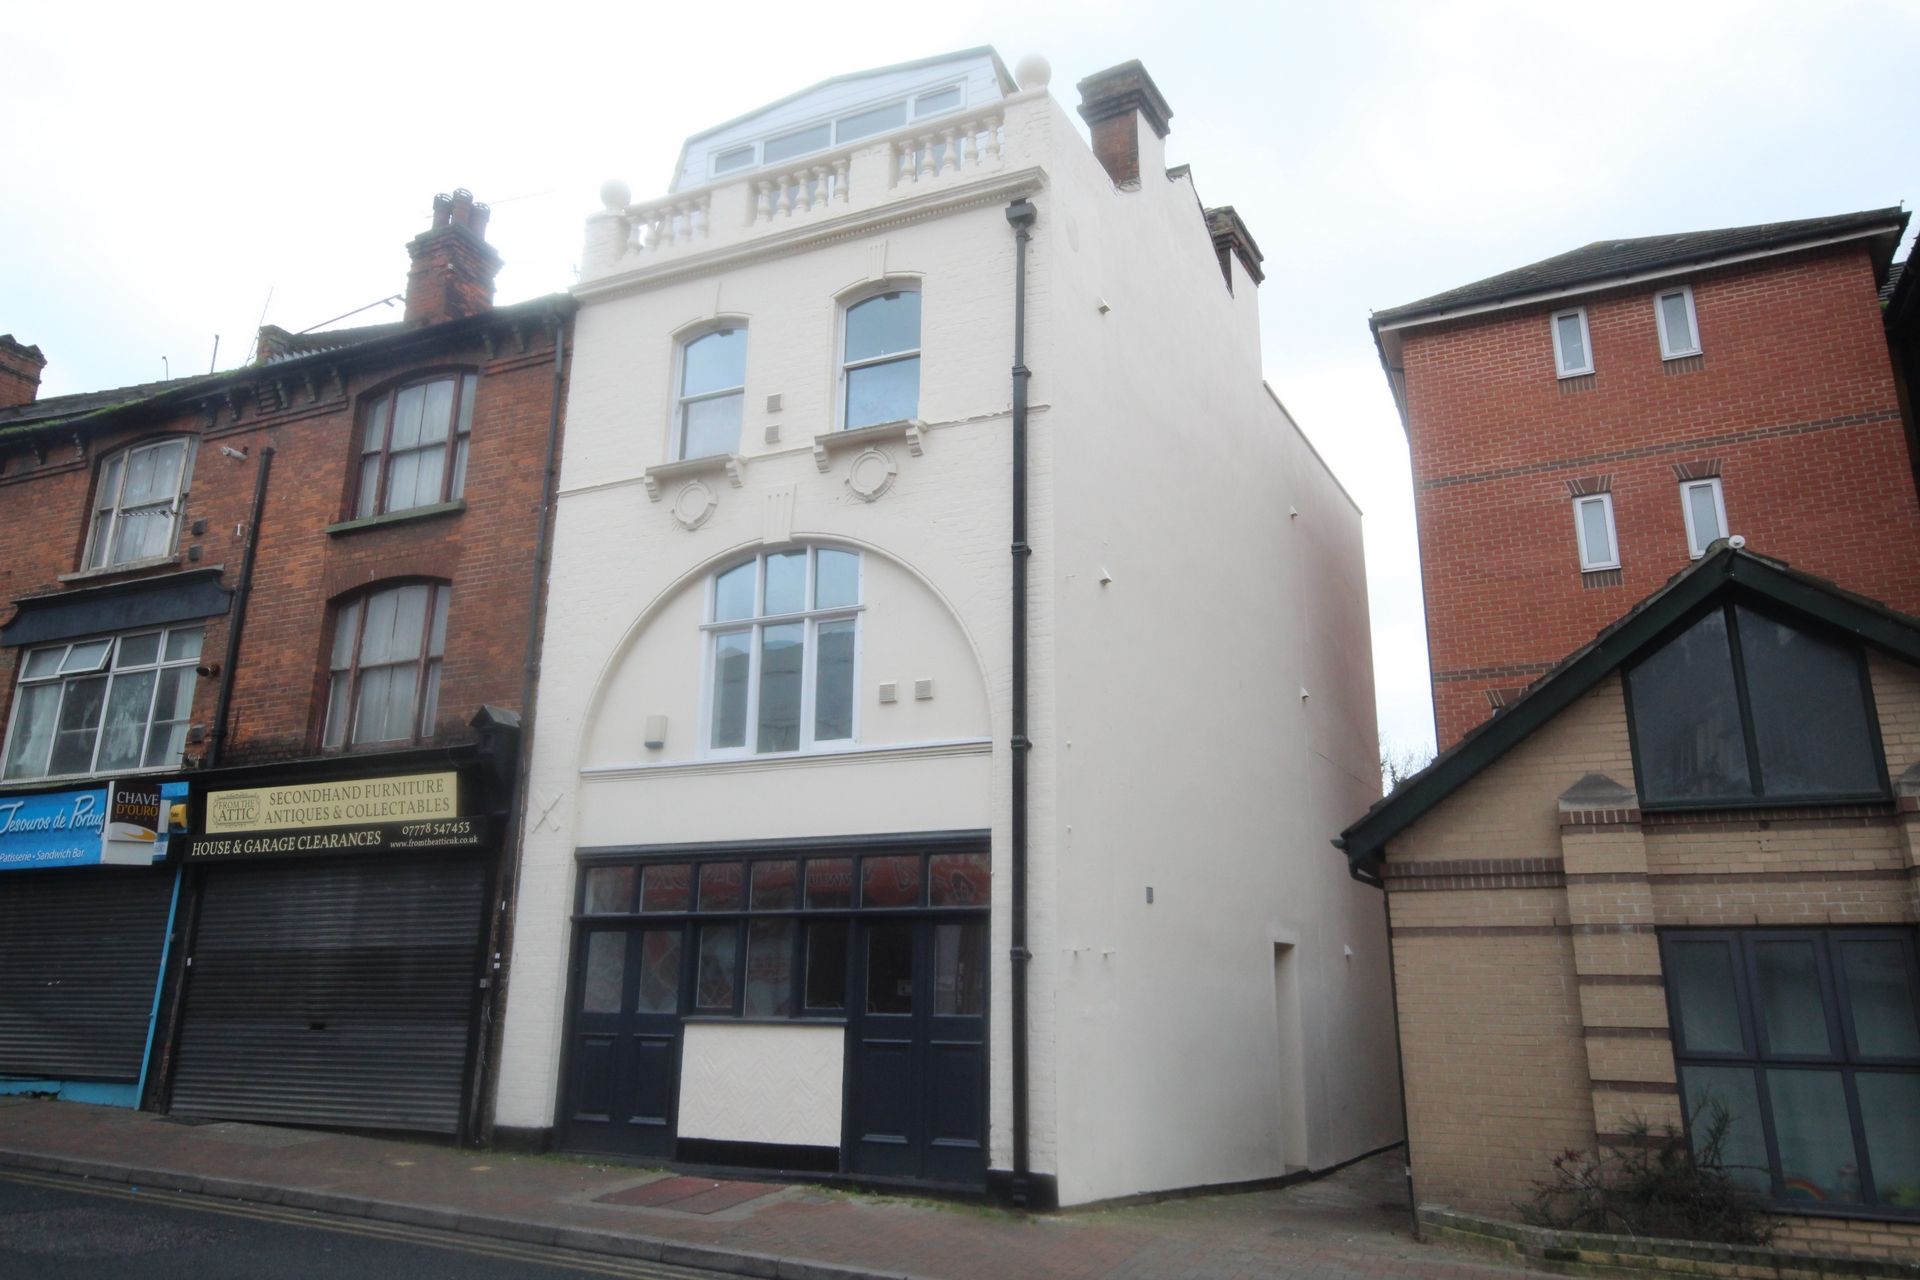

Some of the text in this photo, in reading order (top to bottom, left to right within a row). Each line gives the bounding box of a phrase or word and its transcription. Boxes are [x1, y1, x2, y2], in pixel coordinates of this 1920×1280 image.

[116, 791, 160, 806] CHAVE
[269, 778, 444, 806] SECONDHAND FURNITURE
[116, 803, 160, 817] D'OURO
[218, 799, 255, 810] FROM THE
[264, 797, 450, 825] ANTIQUES & COLLECTABLES
[0, 800, 50, 834] Tesouros
[52, 808, 66, 829] de
[218, 807, 255, 821] ATTIC
[402, 821, 471, 837] 07778 547453
[191, 830, 382, 856] HOUSE & GARAGE CLEARANCES
[390, 834, 479, 849] www.fromtheatticuk.co.uk
[0, 847, 85, 863] Patisserie Sandwich Bar
